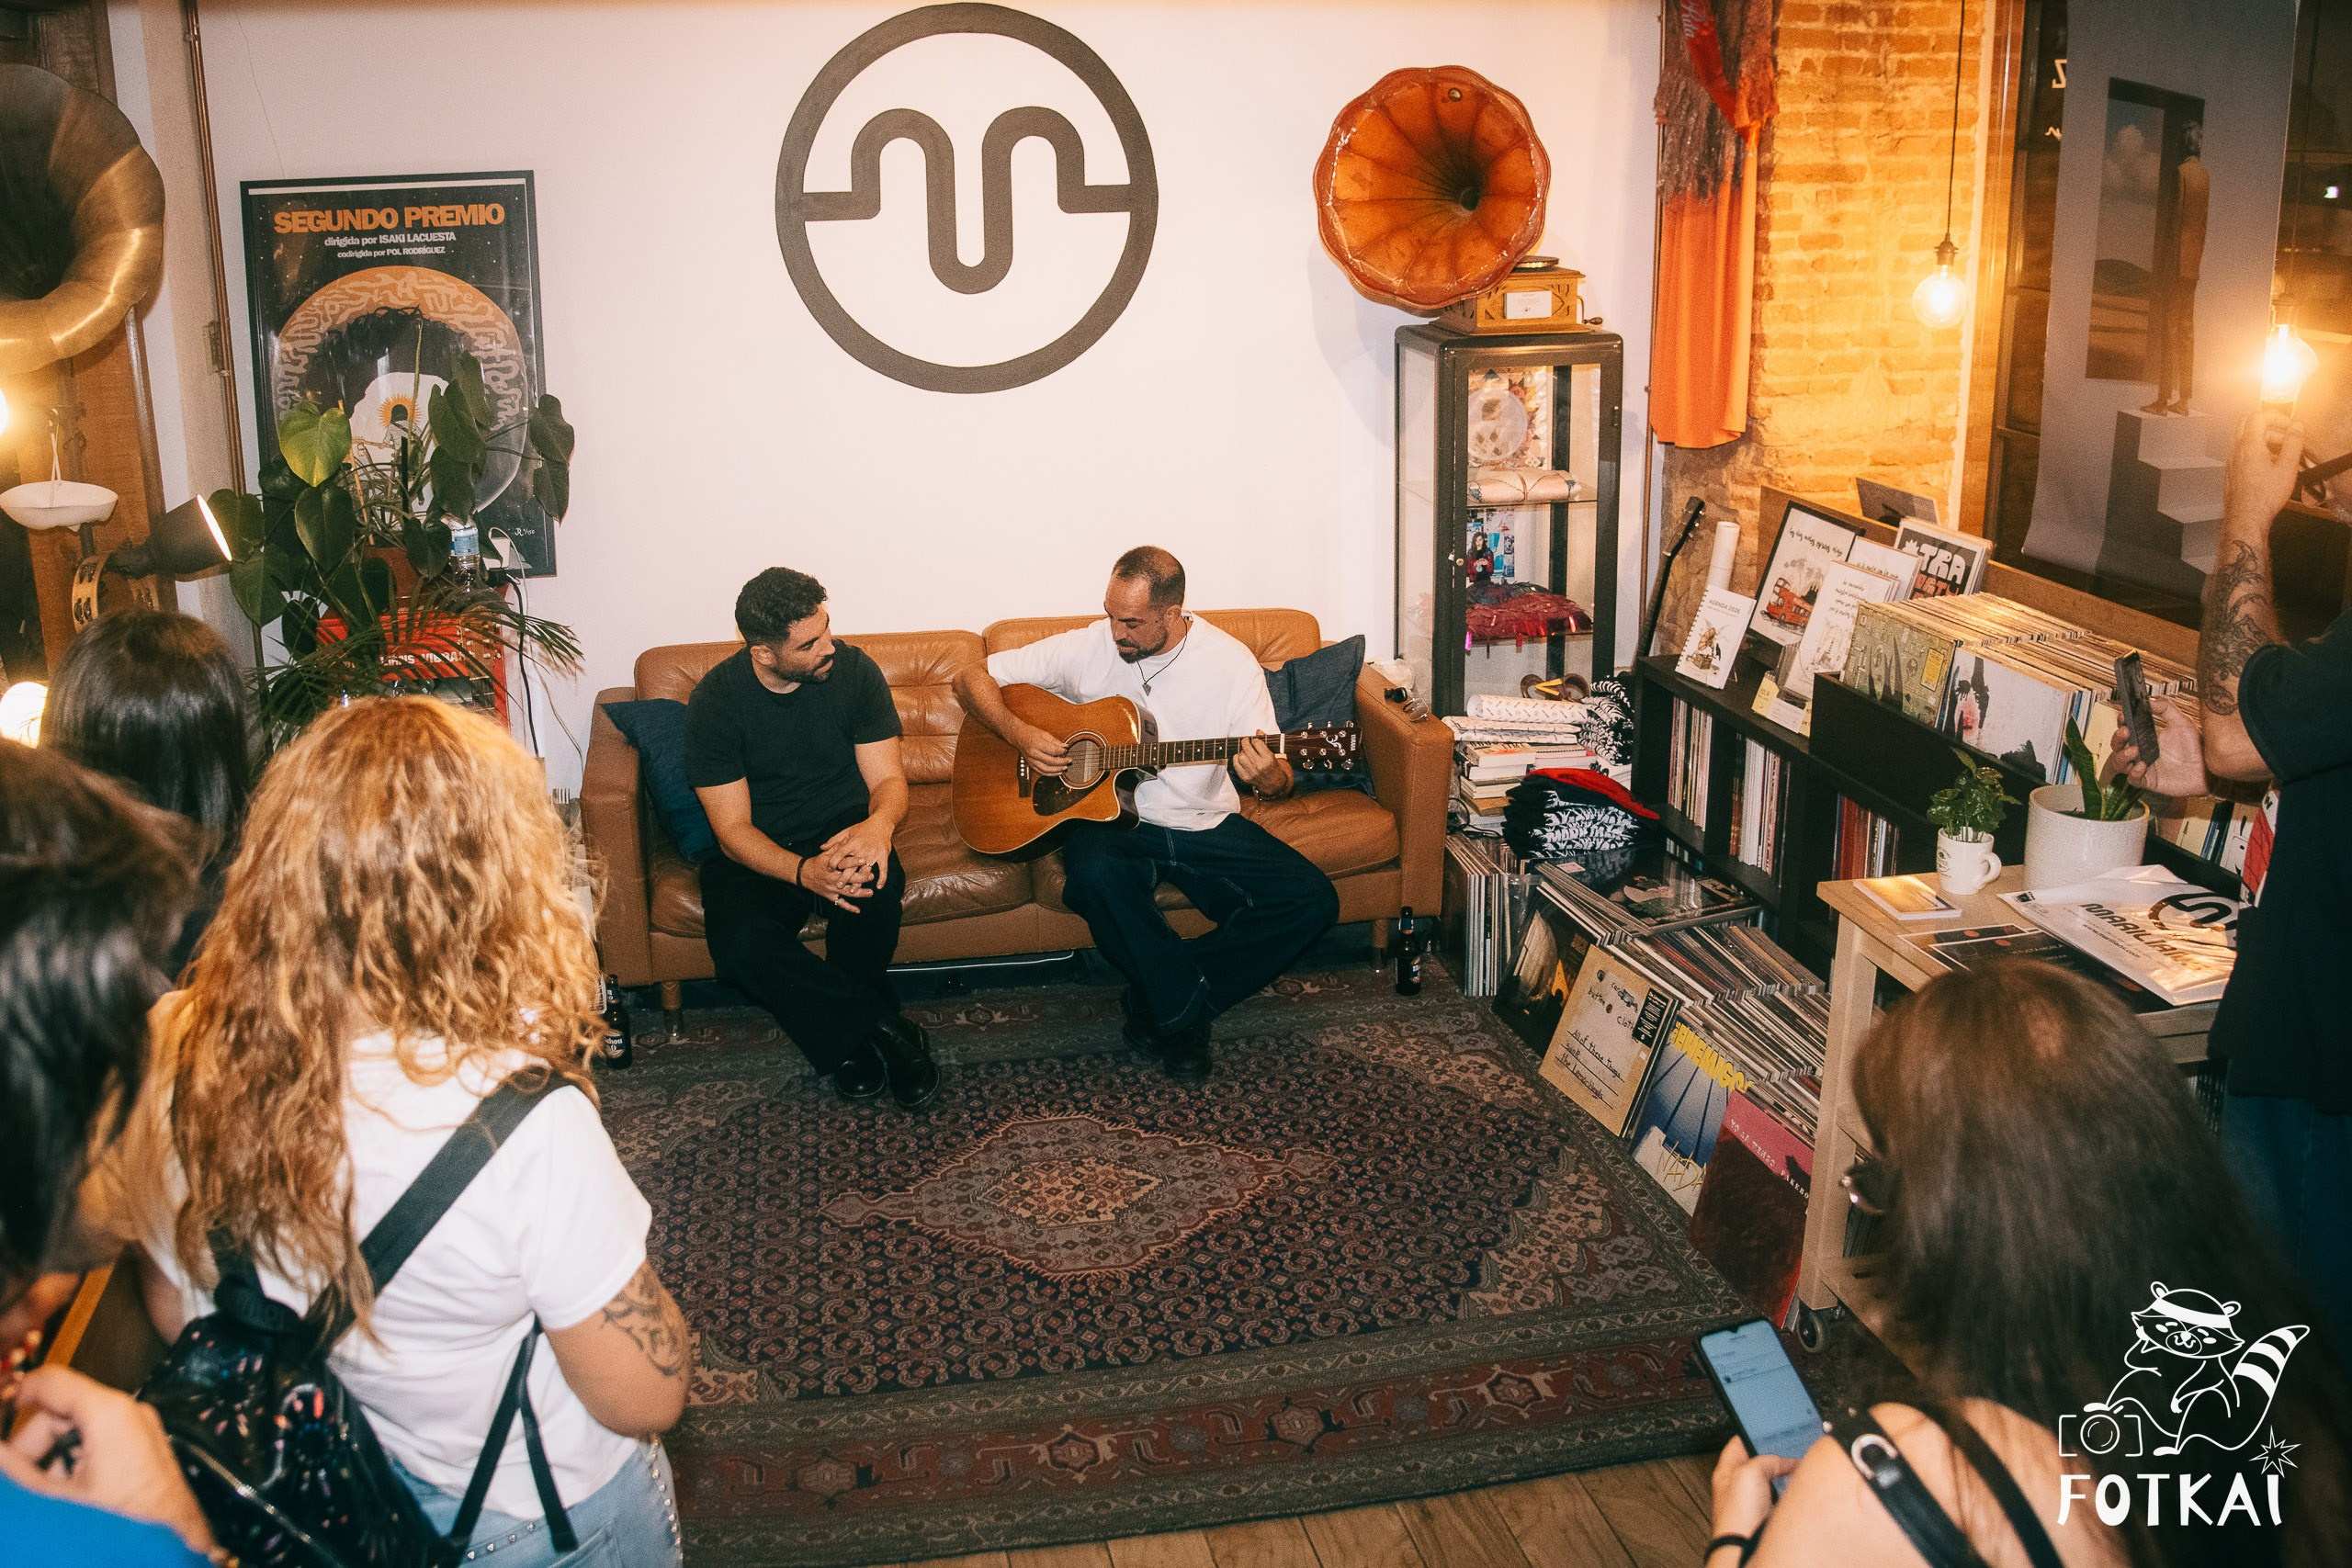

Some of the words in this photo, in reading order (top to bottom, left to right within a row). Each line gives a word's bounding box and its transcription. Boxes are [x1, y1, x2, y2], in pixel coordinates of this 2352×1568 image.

[274, 207, 399, 234] SEGUNDO
[404, 203, 505, 228] PREMIO
[324, 235, 359, 247] dirigida
[361, 236, 378, 246] por
[379, 233, 405, 244] ISAKI
[407, 231, 457, 243] LACUESTA
[337, 249, 372, 258] codirigida
[373, 250, 386, 258] por
[386, 248, 401, 256] POL
[402, 245, 446, 255] RODRÍGUEZ
[1751, 1140, 1776, 1168] TENGO
[1780, 1169, 1809, 1200] FAKEBO
